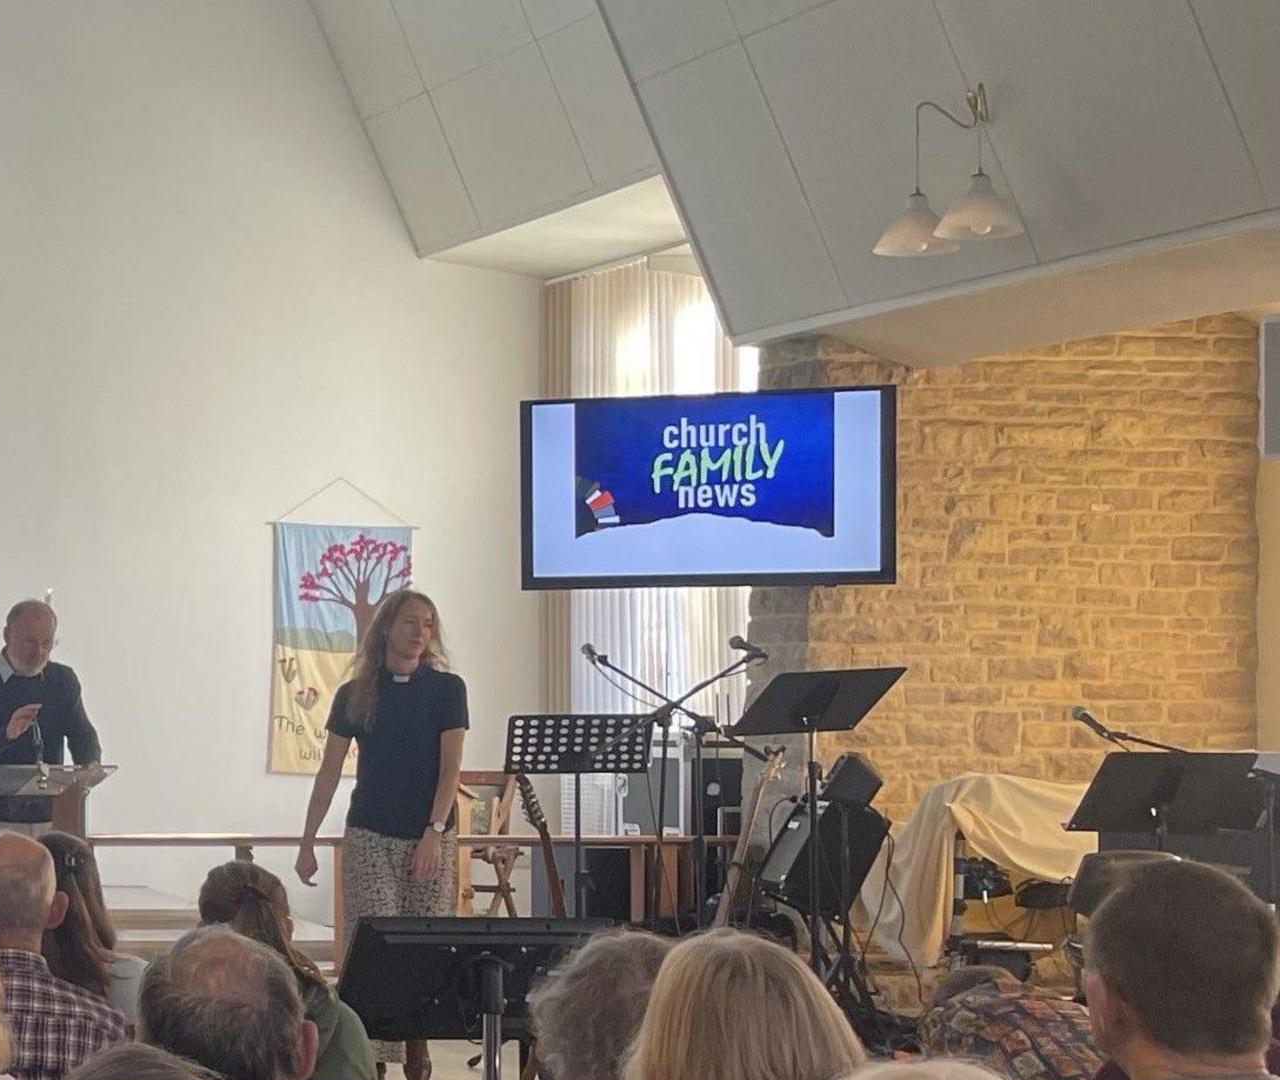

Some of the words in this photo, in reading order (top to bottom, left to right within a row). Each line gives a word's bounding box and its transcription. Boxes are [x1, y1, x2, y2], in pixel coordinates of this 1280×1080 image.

[663, 414, 766, 448] church
[651, 439, 784, 494] FAMILY
[677, 481, 757, 508] news
[273, 715, 305, 736] The
